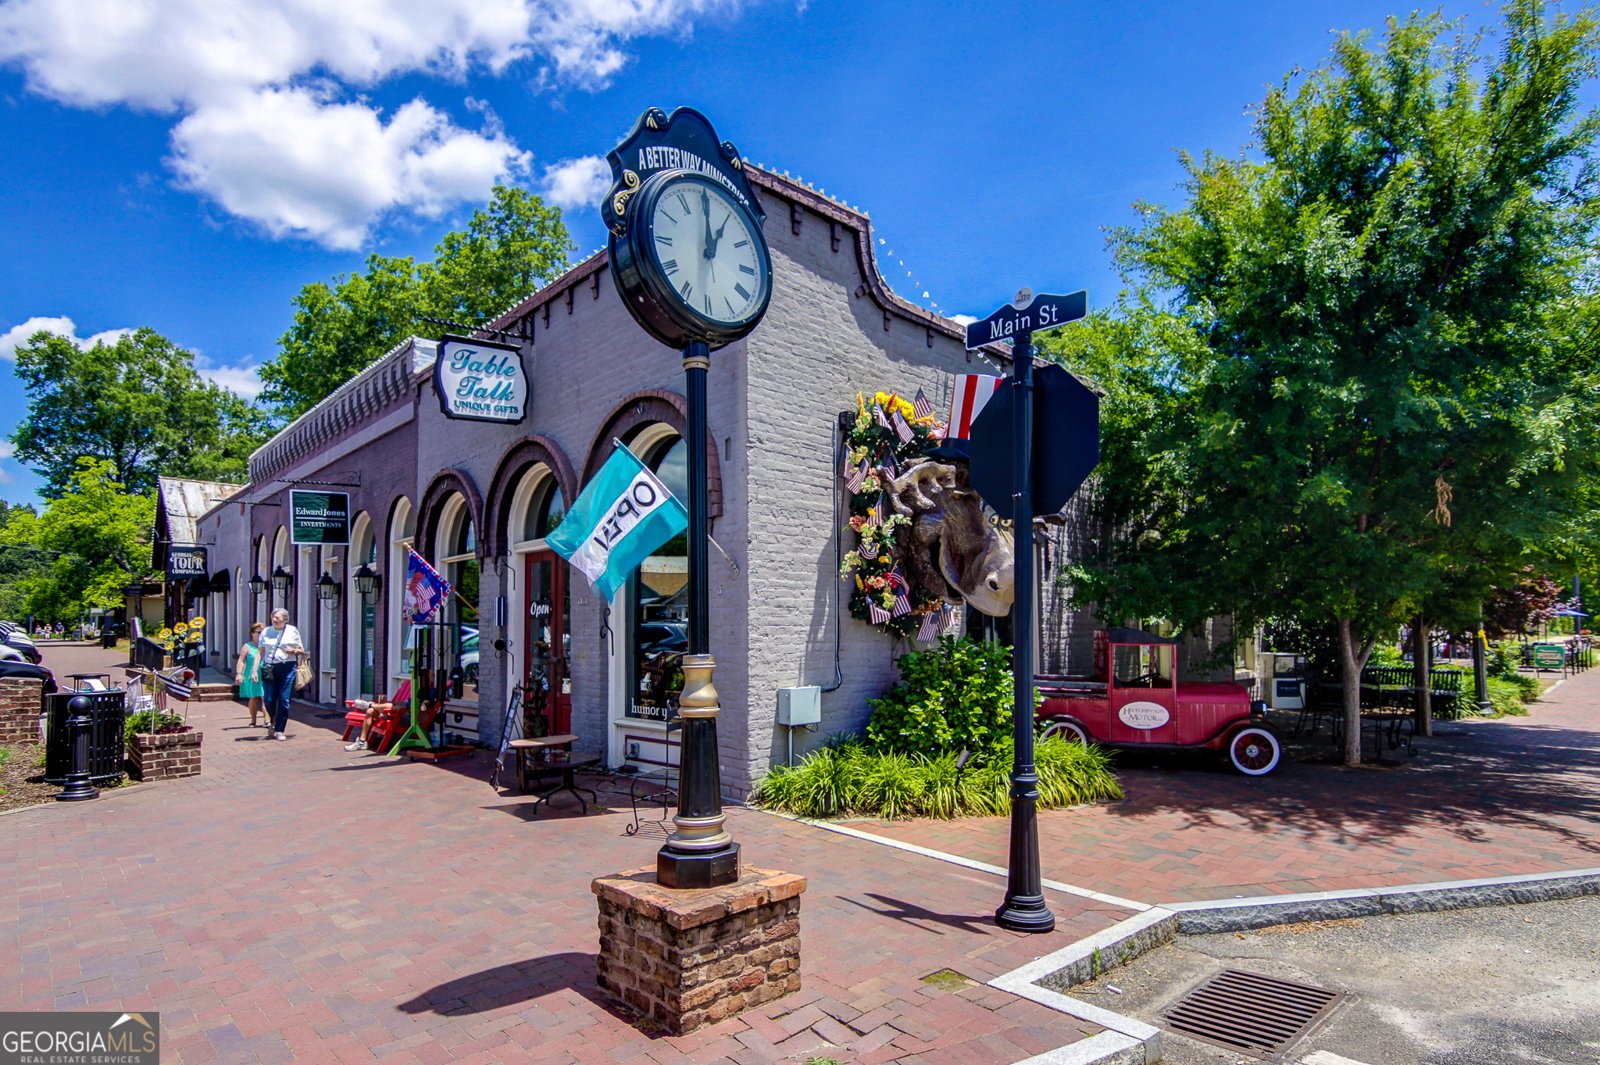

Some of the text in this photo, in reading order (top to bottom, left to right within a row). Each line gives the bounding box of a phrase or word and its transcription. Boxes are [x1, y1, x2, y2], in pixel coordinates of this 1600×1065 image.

[639, 148, 647, 170] A
[646, 146, 681, 170] BETTER
[681, 150, 701, 171] WAY
[990, 304, 1058, 339] Main St
[451, 349, 516, 377] Table
[457, 376, 515, 401] Talk
[454, 400, 519, 414] UNIQUE GIFTS
[169, 556, 204, 571] TOUR
[530, 601, 550, 618] Open
[631, 698, 660, 716] humor
